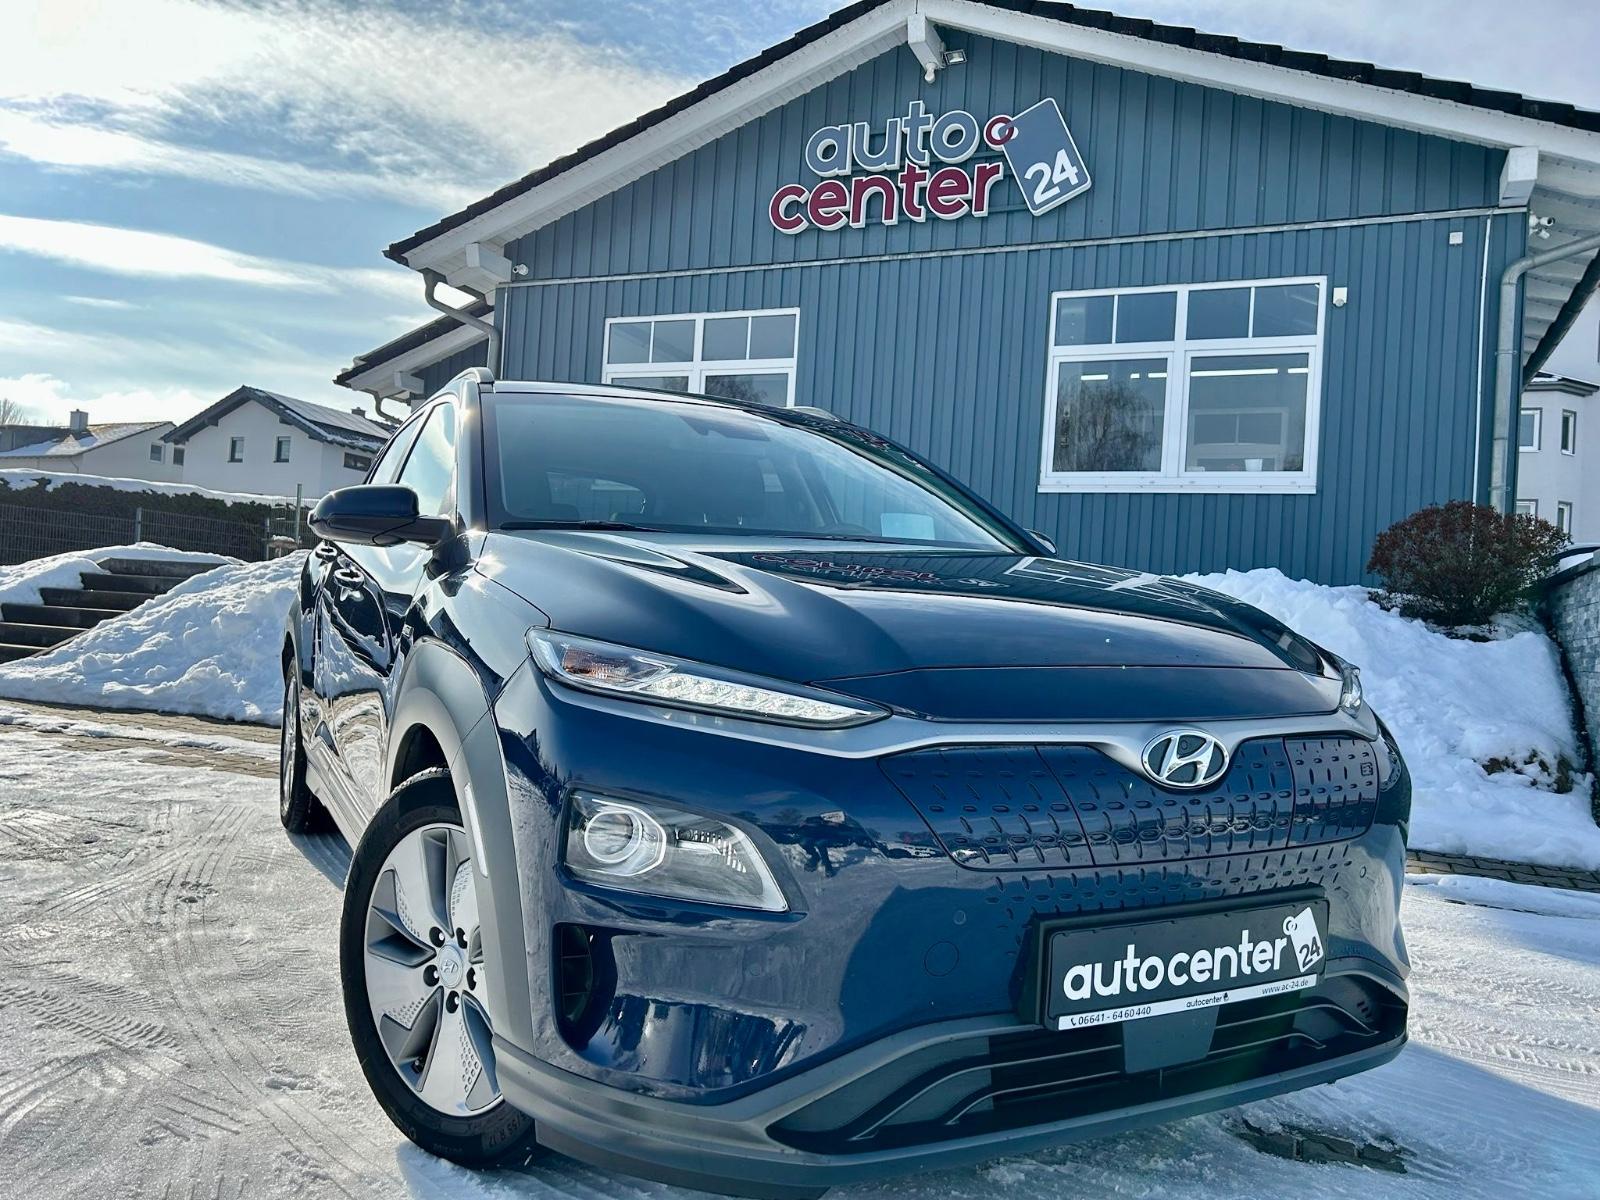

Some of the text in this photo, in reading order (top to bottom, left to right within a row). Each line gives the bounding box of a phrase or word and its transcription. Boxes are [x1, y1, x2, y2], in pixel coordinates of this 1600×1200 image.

[805, 100, 980, 177] auto
[769, 159, 1004, 234] center
[1024, 149, 1079, 205] 24
[1063, 929, 1287, 1001] autocenter
[1299, 942, 1321, 967] 24
[1186, 995, 1223, 1008] autocenter
[1262, 980, 1309, 995] www.ac-24.de
[1078, 1013, 1105, 1026] 06641
